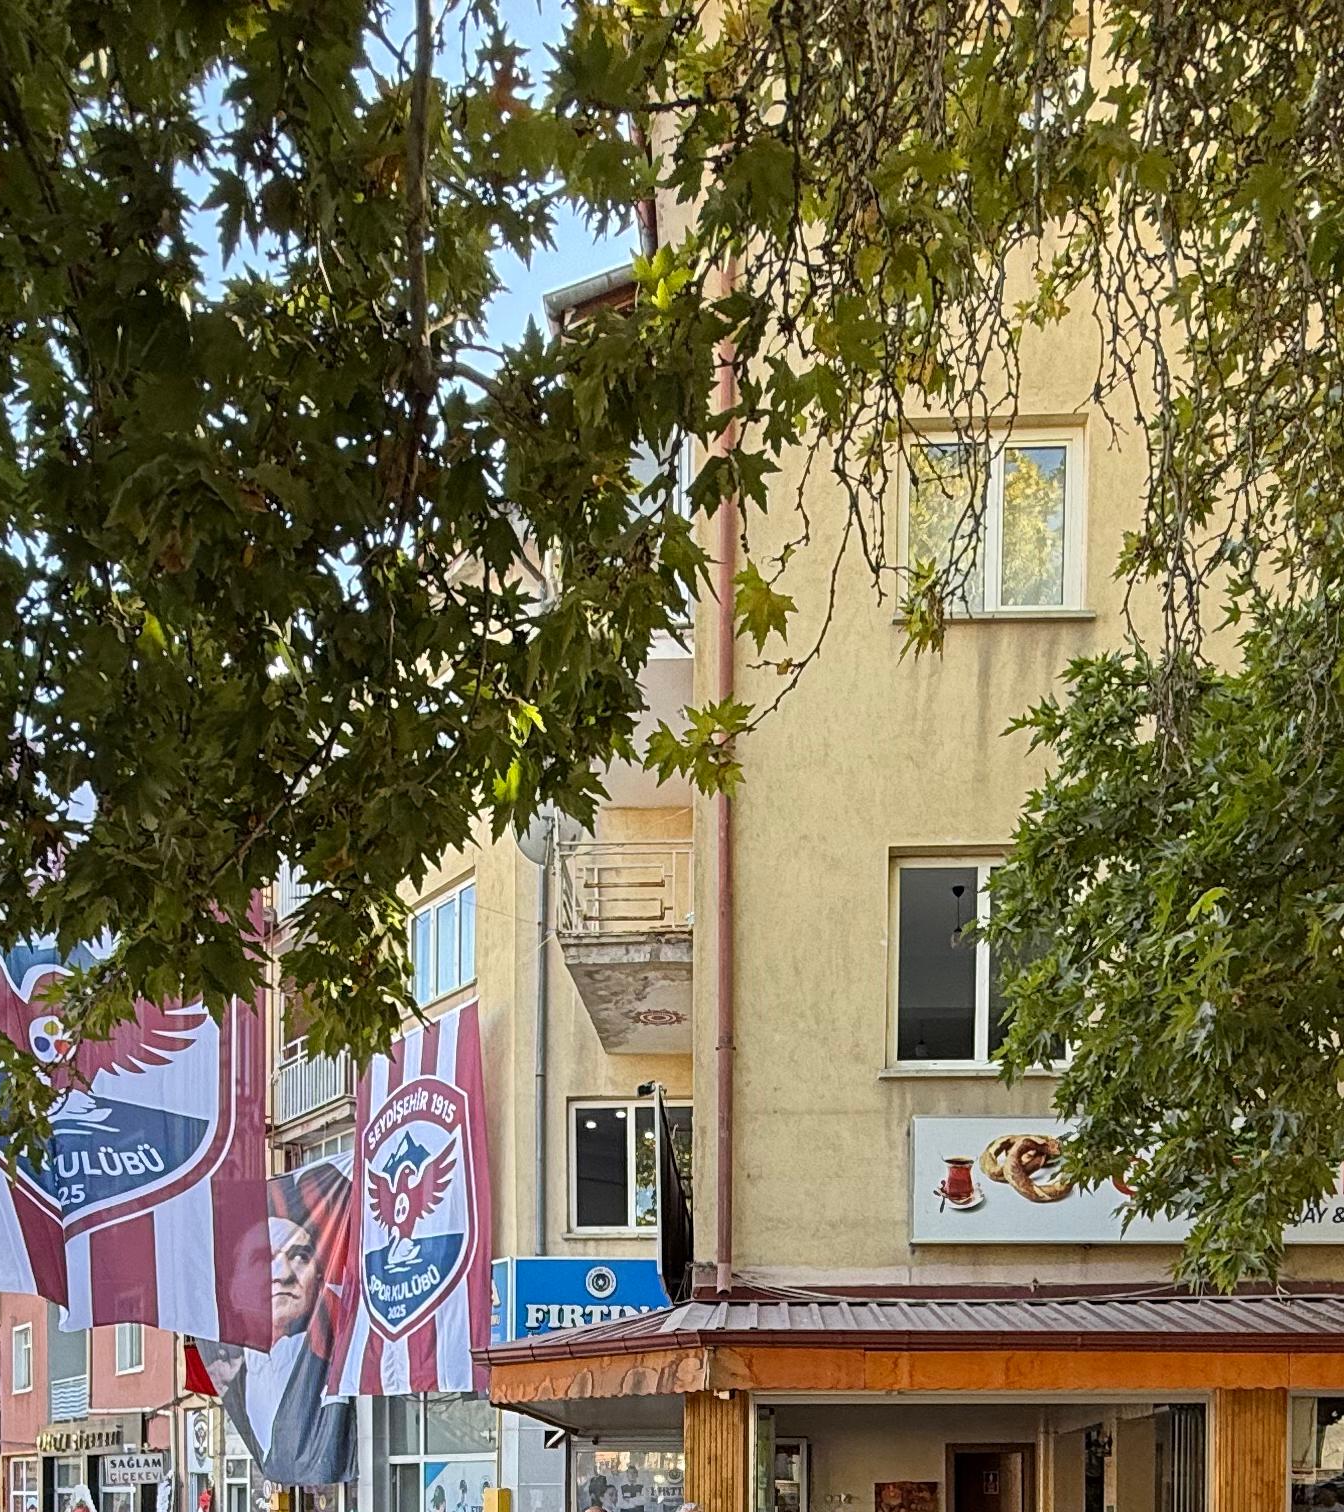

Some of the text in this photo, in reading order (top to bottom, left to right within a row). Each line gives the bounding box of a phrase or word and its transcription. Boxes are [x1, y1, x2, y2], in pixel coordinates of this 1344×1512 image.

[368, 1086, 456, 1150] SEYDİŞEHİR 1915
[525, 1304, 666, 1329] FIRTIN
[109, 1456, 163, 1469] SAĞLAM
